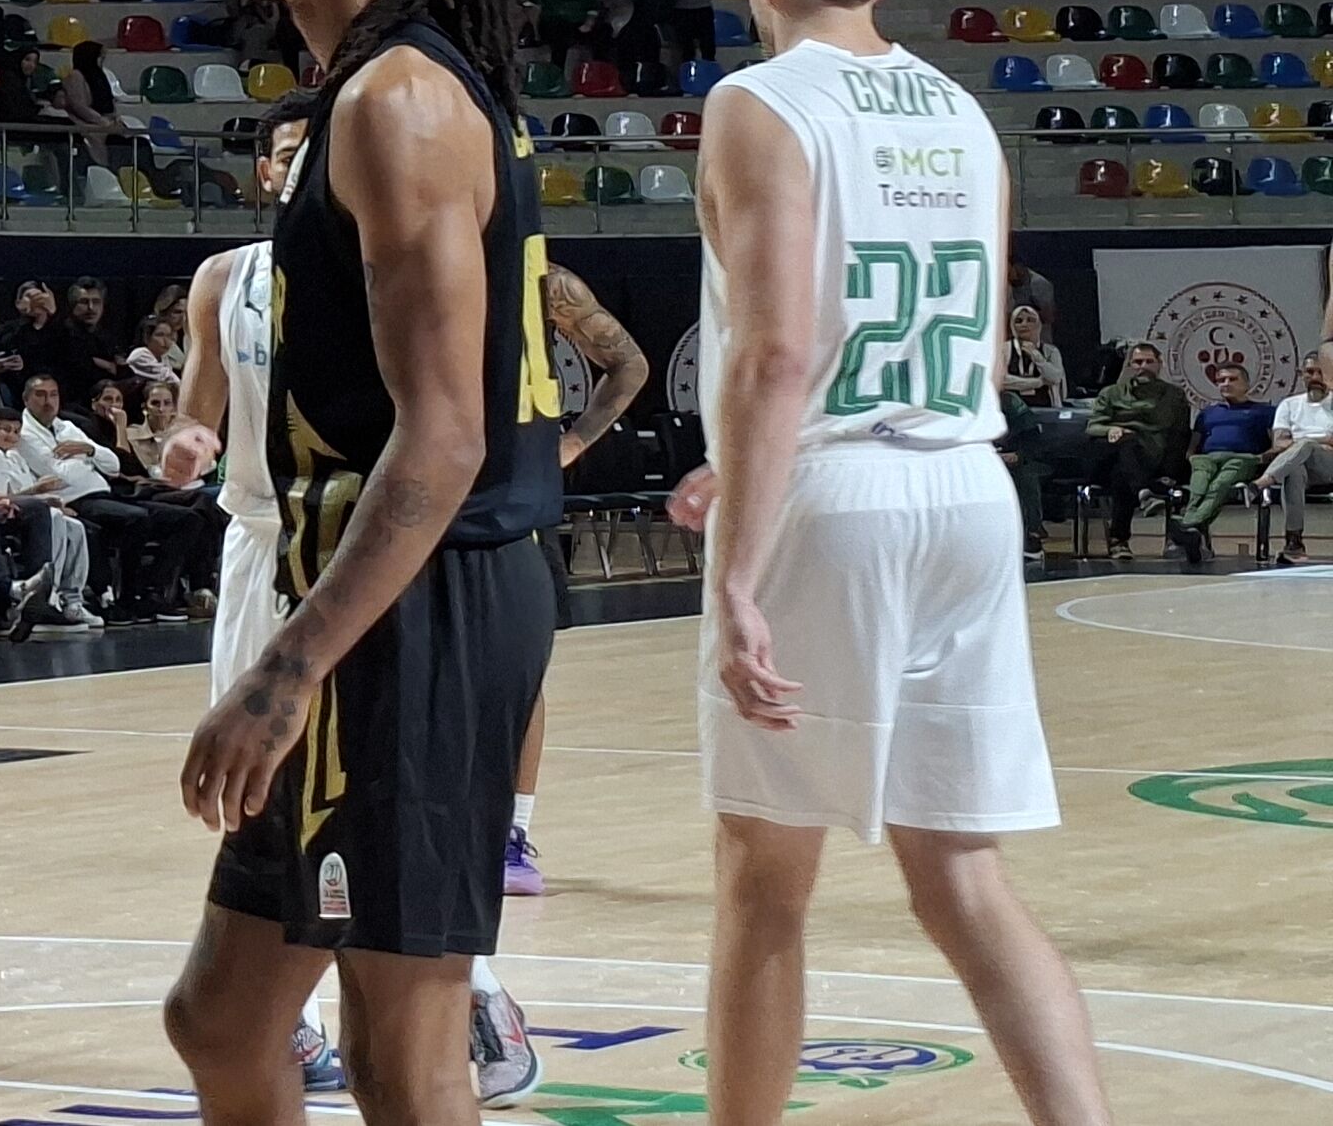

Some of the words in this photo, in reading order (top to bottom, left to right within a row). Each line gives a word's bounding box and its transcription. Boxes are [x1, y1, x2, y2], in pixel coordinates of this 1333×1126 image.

[899, 147, 965, 177] MCT
[877, 183, 968, 209] Technic
[824, 240, 990, 417] 22
